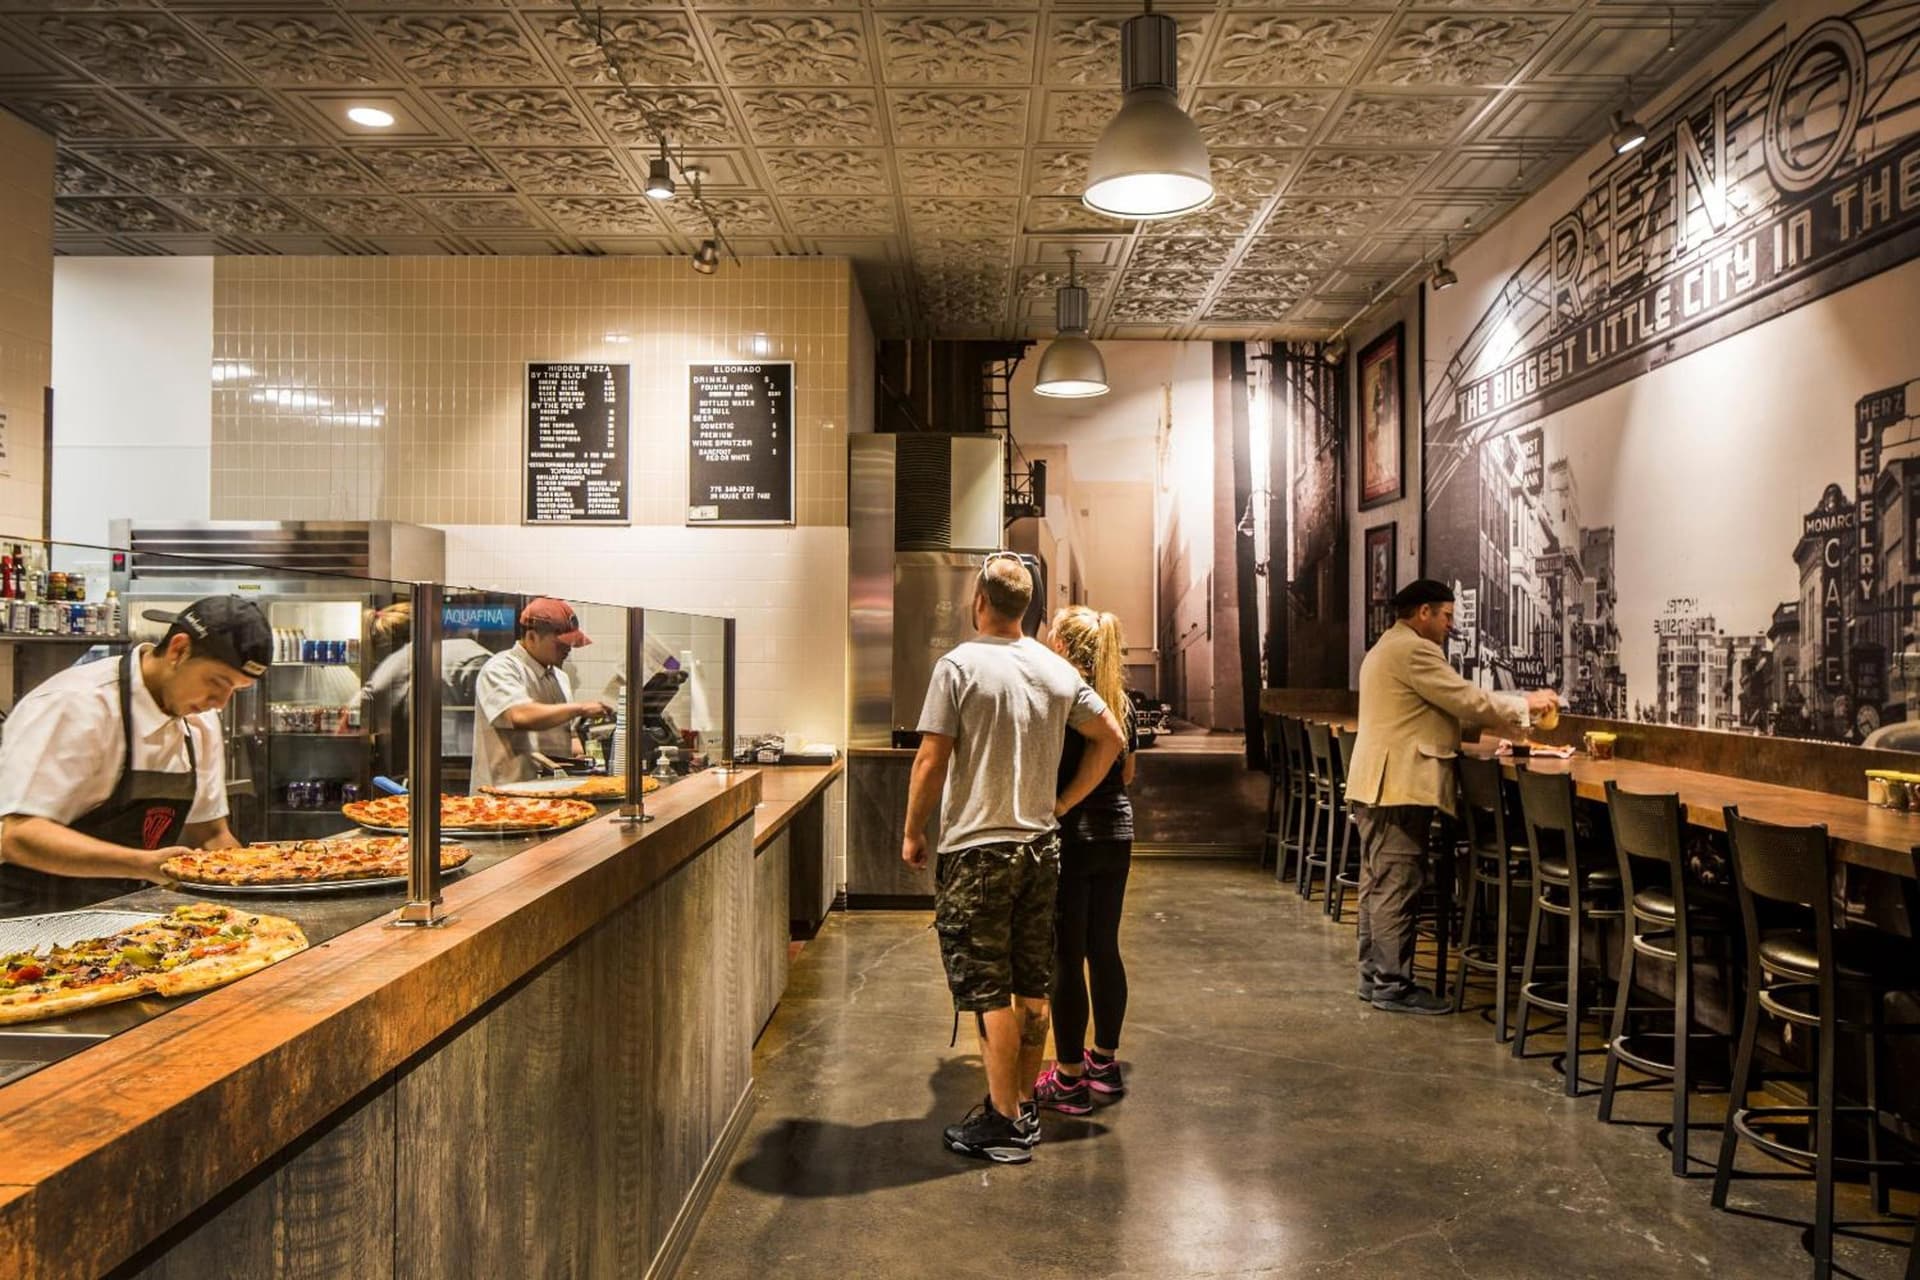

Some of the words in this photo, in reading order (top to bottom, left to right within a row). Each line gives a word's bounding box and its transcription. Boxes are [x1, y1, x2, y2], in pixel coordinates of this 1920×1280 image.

[1549, 16, 1868, 334] RENO
[1459, 384, 1489, 423] THE
[1493, 338, 1577, 410] BIGGEST
[1586, 283, 1671, 365] LITTLE
[1682, 240, 1758, 319] CITY
[1832, 155, 1920, 242] THE
[693, 376, 727, 384] DRINKS
[1859, 421, 1875, 600] JEWELRY
[444, 608, 505, 626] AQUAFINA
[1824, 537, 1842, 687] CAFE
